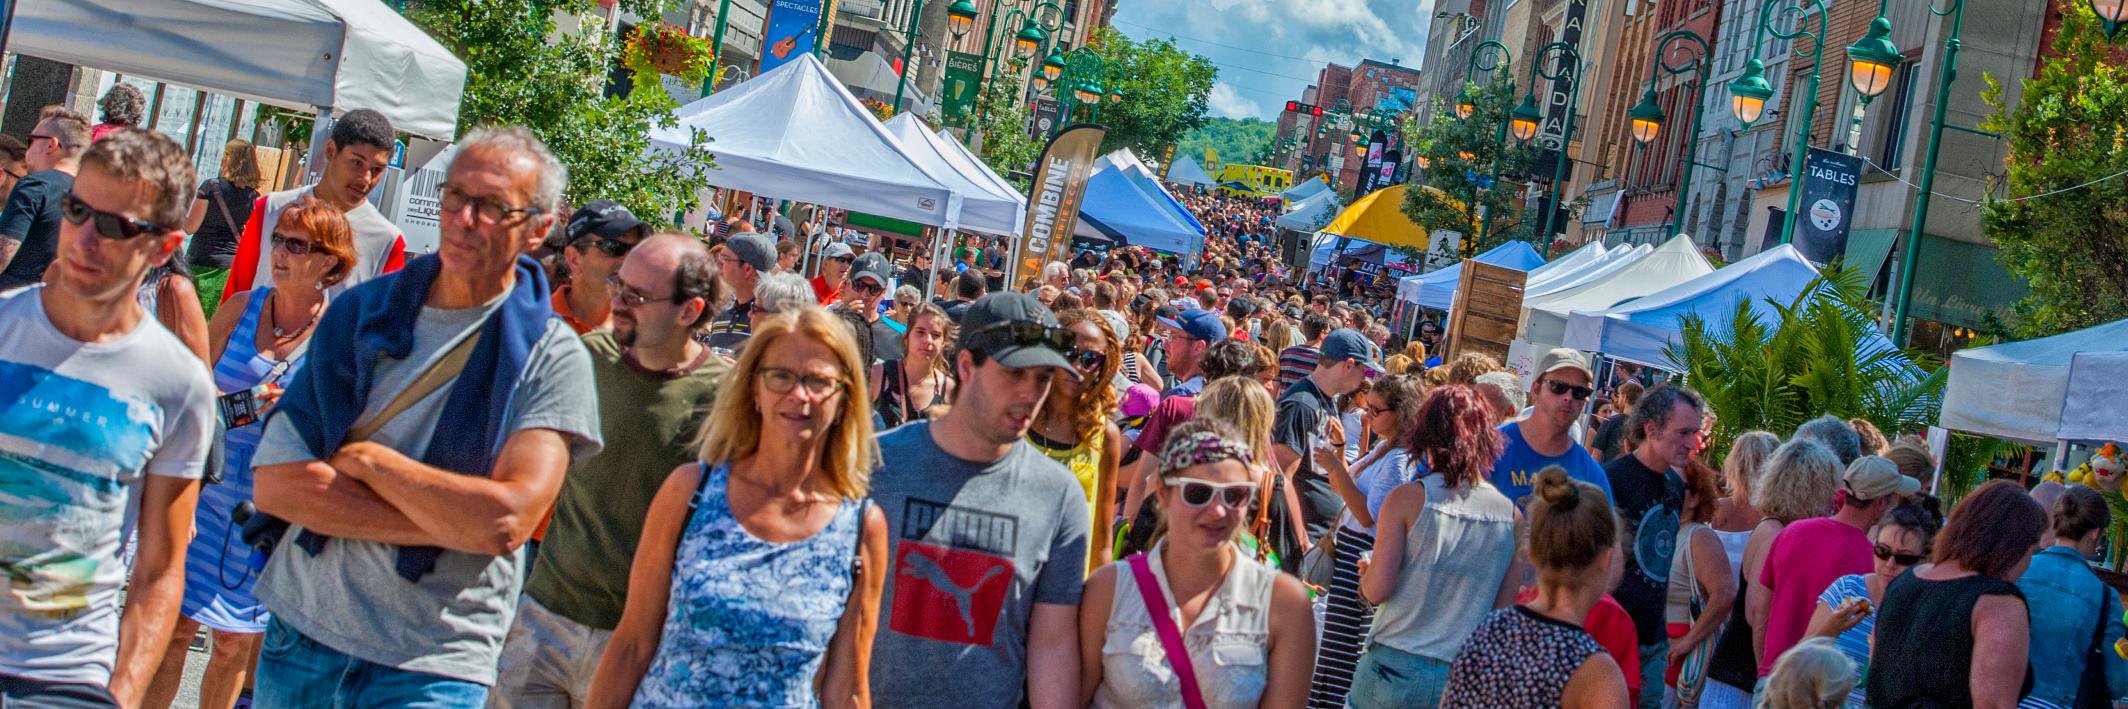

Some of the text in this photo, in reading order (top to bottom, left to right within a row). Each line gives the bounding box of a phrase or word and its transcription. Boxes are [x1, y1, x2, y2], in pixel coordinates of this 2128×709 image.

[776, 0, 818, 14] SPECTACLES
[1810, 165, 1855, 186] TABLES
[409, 197, 440, 208] comm
[1028, 157, 1070, 253] COMBINE
[20, 395, 108, 428] SUMMER
[1511, 469, 1538, 487] MA
[905, 499, 1015, 555] PUMA
